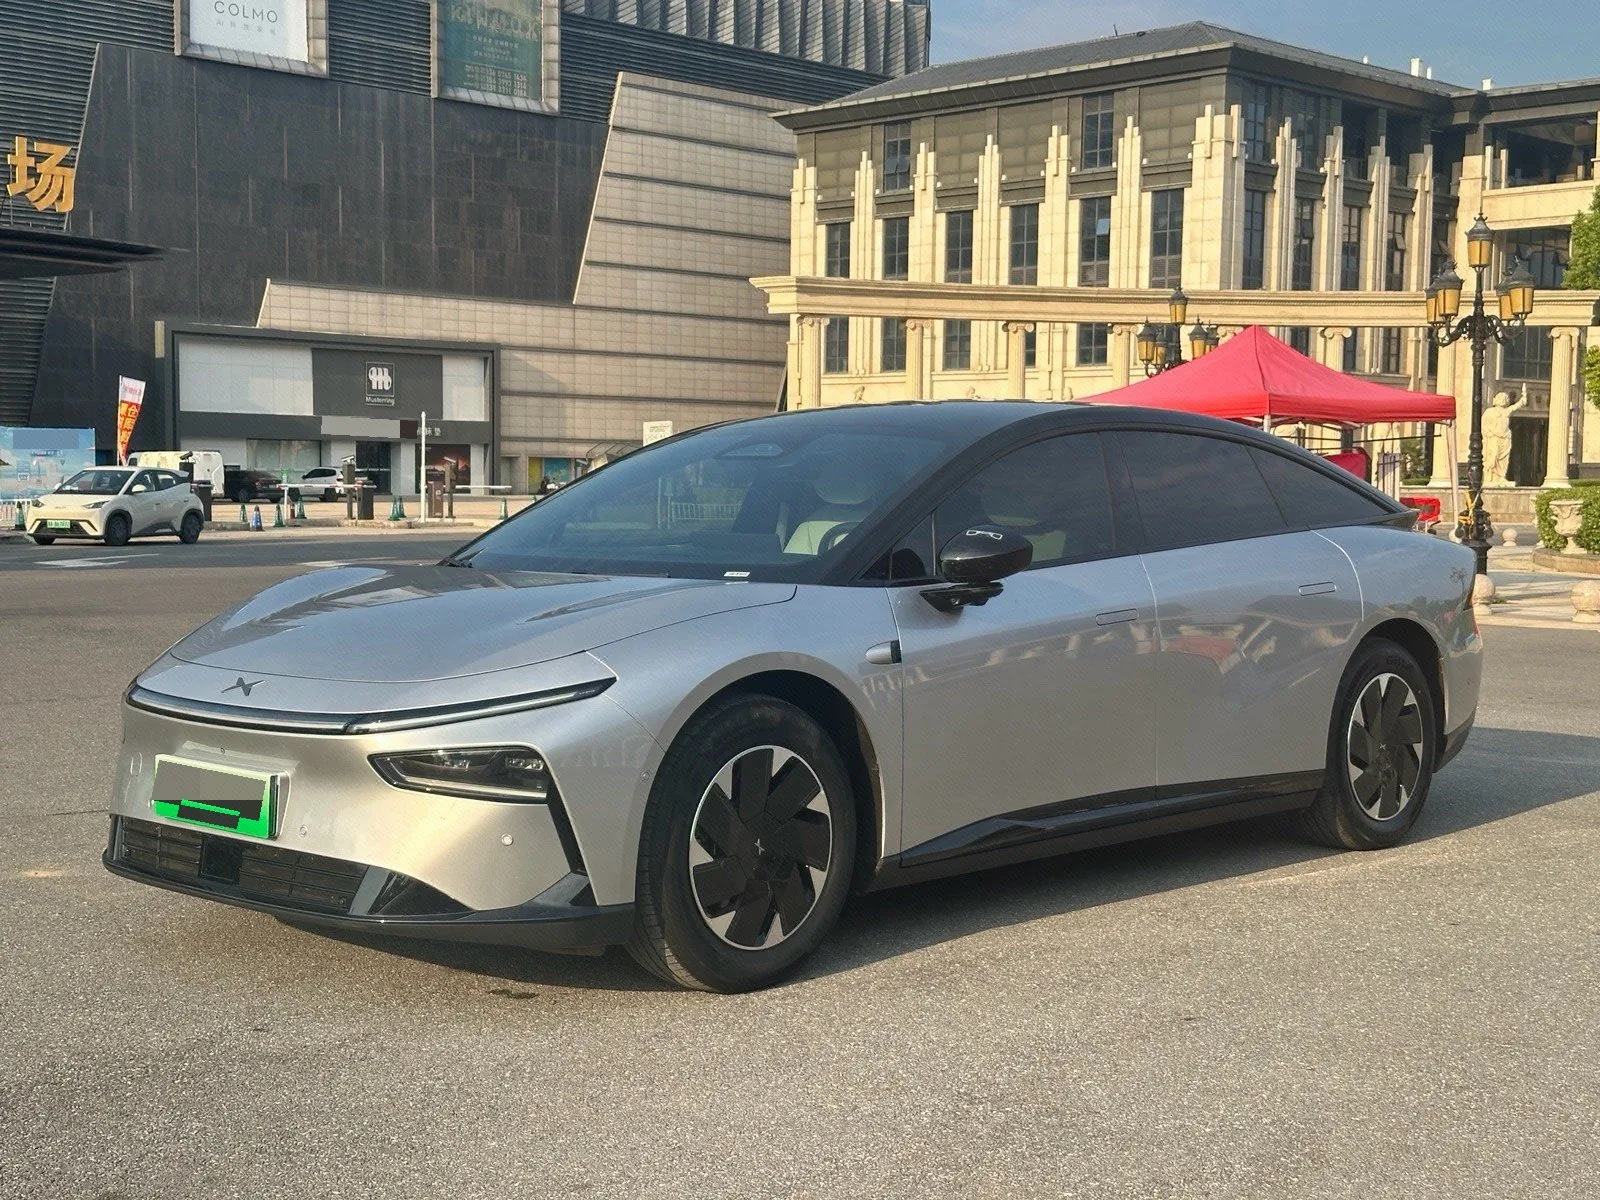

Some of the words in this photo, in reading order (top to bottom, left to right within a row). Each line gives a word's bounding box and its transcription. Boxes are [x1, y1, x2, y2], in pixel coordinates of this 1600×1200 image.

[214, 1, 278, 23] COLMO
[7, 136, 76, 213] 场
[365, 396, 395, 407] Musterring
